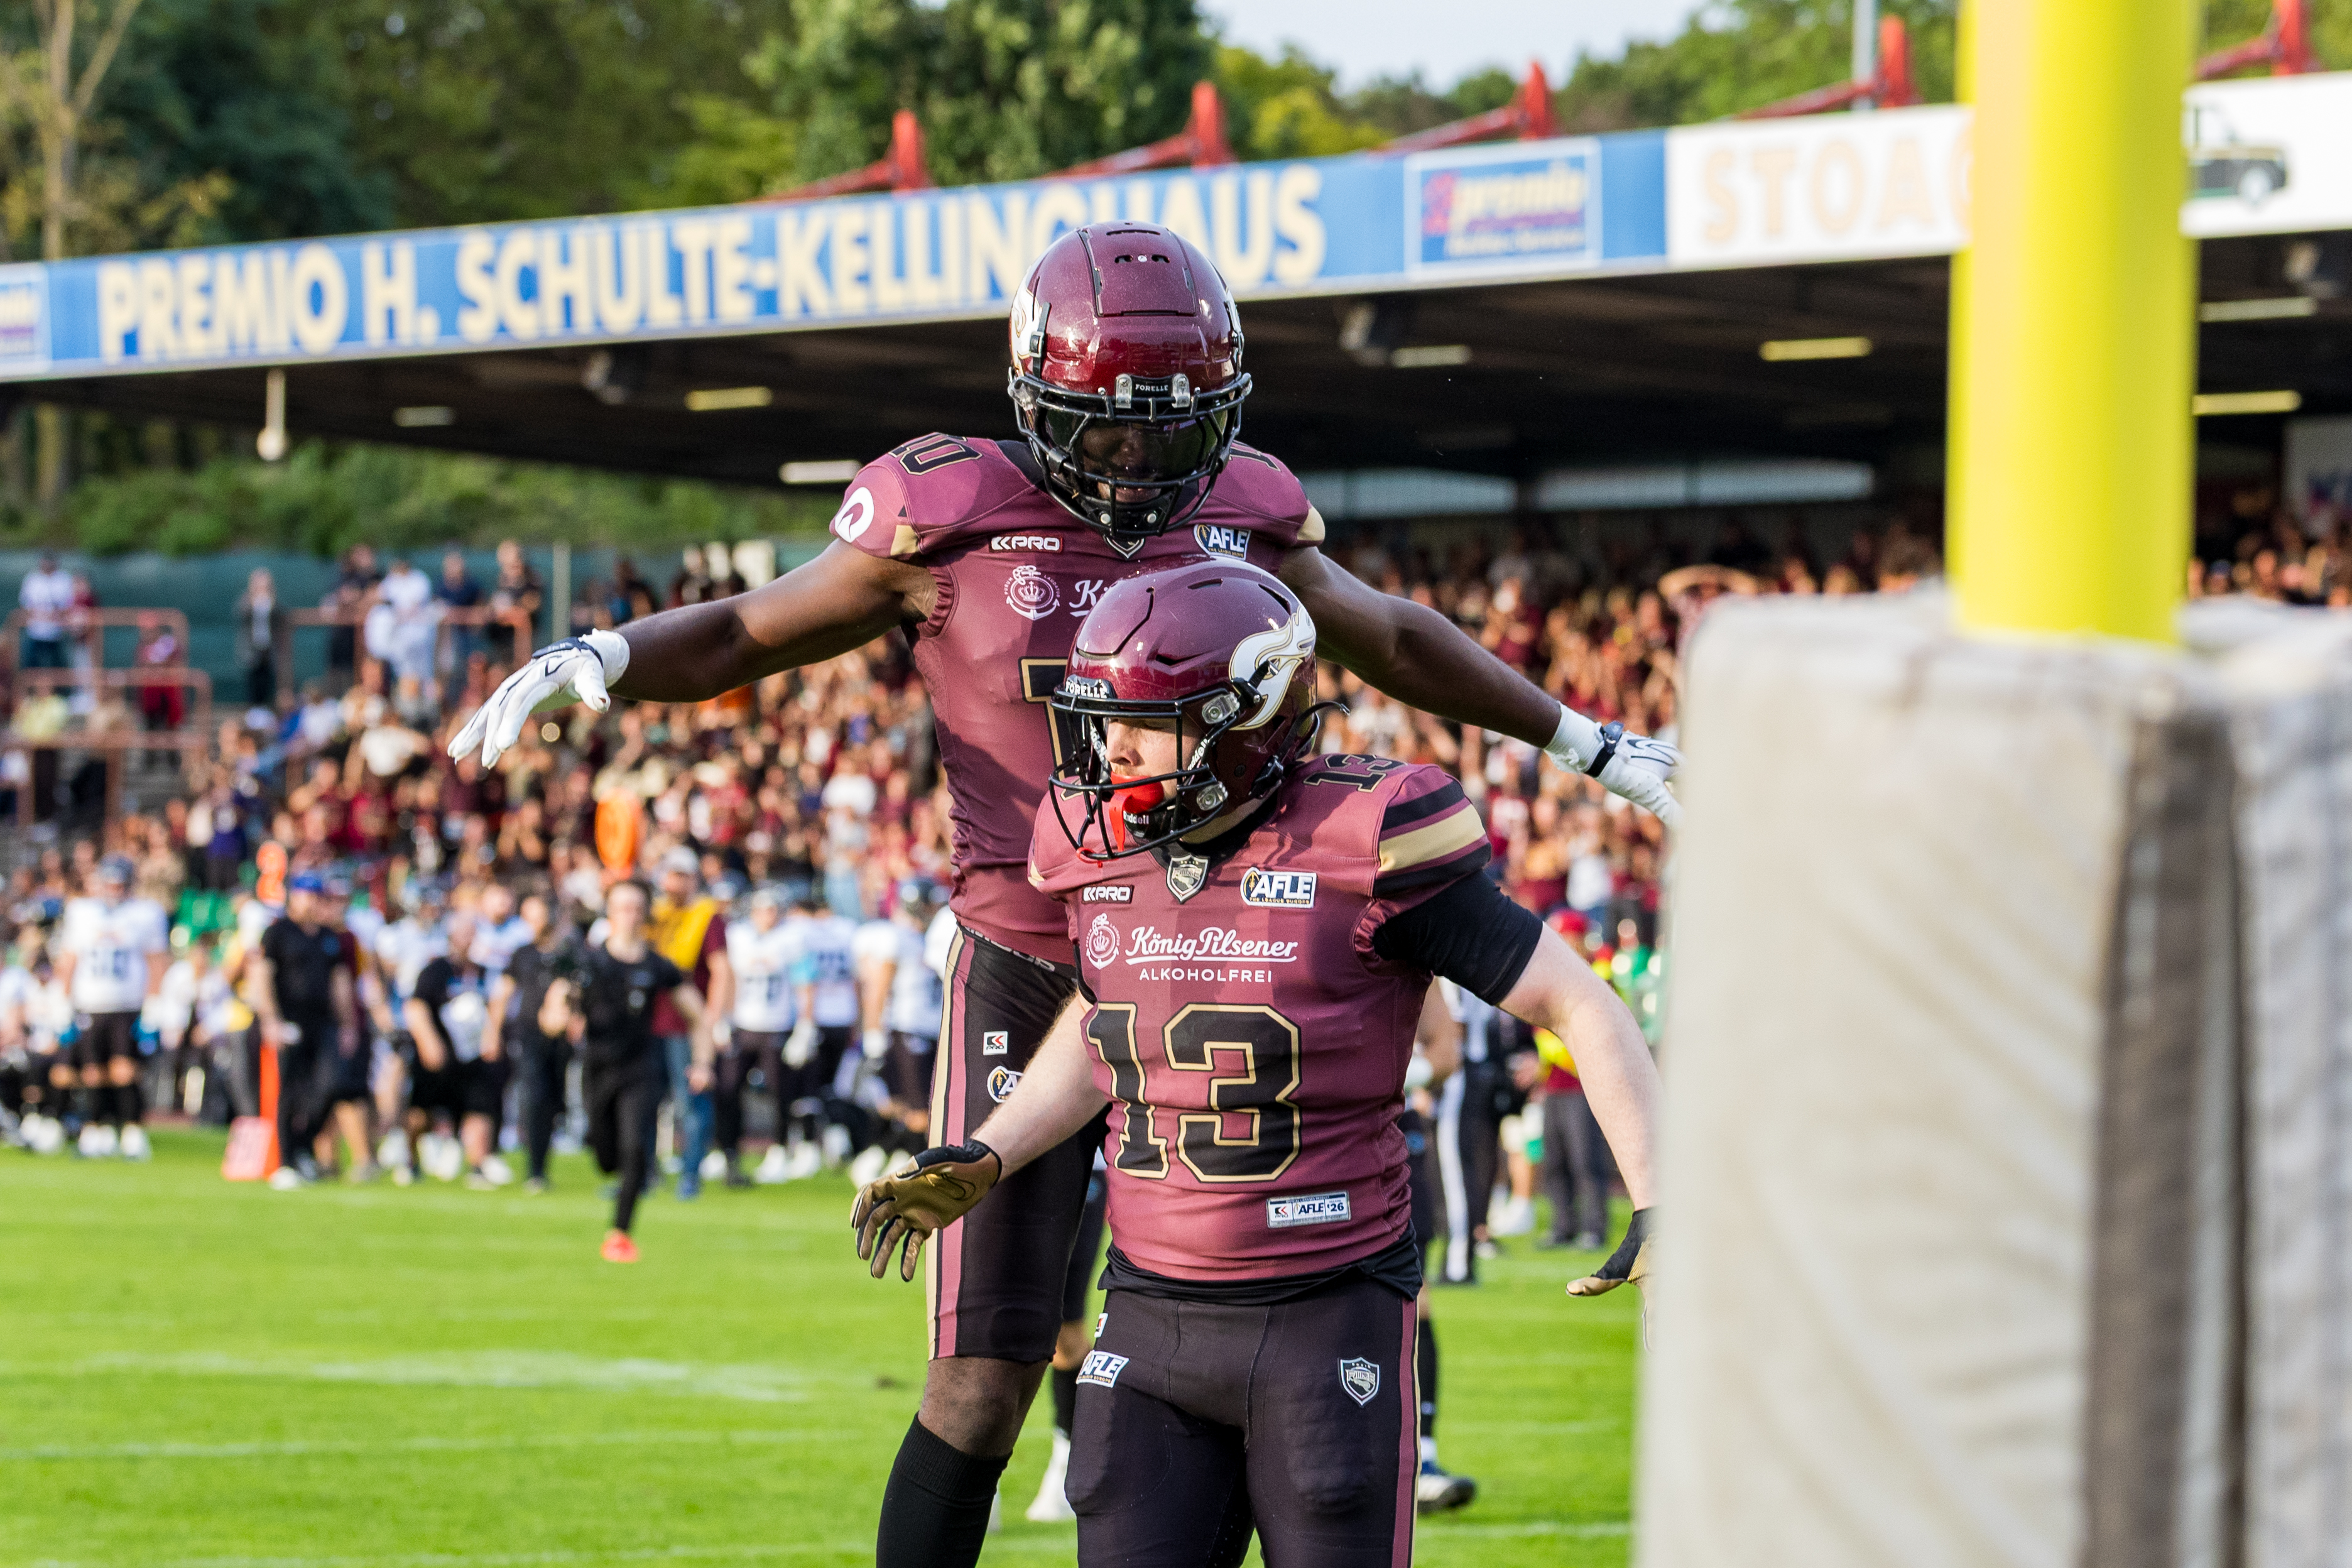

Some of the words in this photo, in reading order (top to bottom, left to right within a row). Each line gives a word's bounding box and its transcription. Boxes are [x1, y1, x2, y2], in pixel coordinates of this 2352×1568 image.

[98, 242, 348, 366] PREMIO
[361, 237, 438, 349] H.
[1135, 384, 1168, 392] FORELLE
[1208, 526, 1248, 552] AFLE
[1065, 680, 1108, 699] FORELLE
[1251, 874, 1312, 899] AFLE
[1124, 925, 1197, 961] König
[1195, 926, 1298, 957] Pilsener
[1139, 967, 1272, 983] ALKOHOLFREI
[1086, 1002, 1302, 1183] 13
[1298, 1202, 1324, 1214] AFLE
[1327, 1202, 1344, 1212] '26
[1080, 1354, 1124, 1379] AFLE
